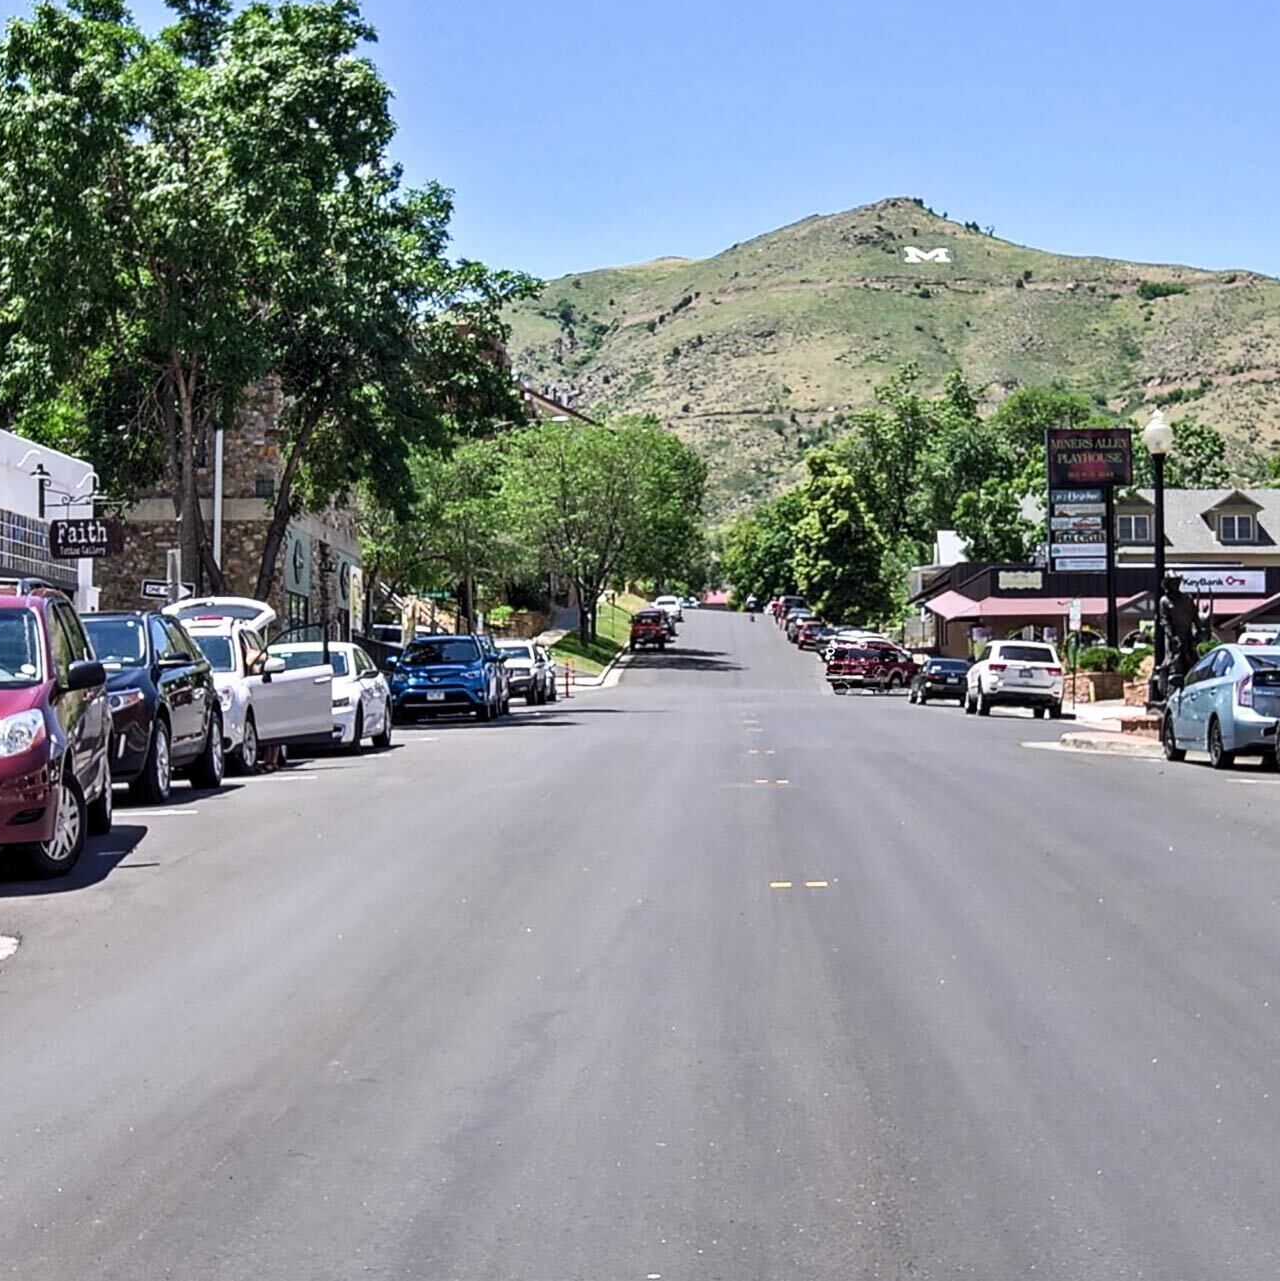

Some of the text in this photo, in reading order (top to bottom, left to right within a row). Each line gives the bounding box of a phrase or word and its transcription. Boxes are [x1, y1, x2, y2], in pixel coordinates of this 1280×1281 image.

[903, 246, 951, 263] M
[1051, 438, 1127, 449] MINERS ALLEY
[1056, 452, 1122, 464] PLAYHOUSE
[56, 520, 108, 543] Faith
[1182, 578, 1223, 588] KeyBank
